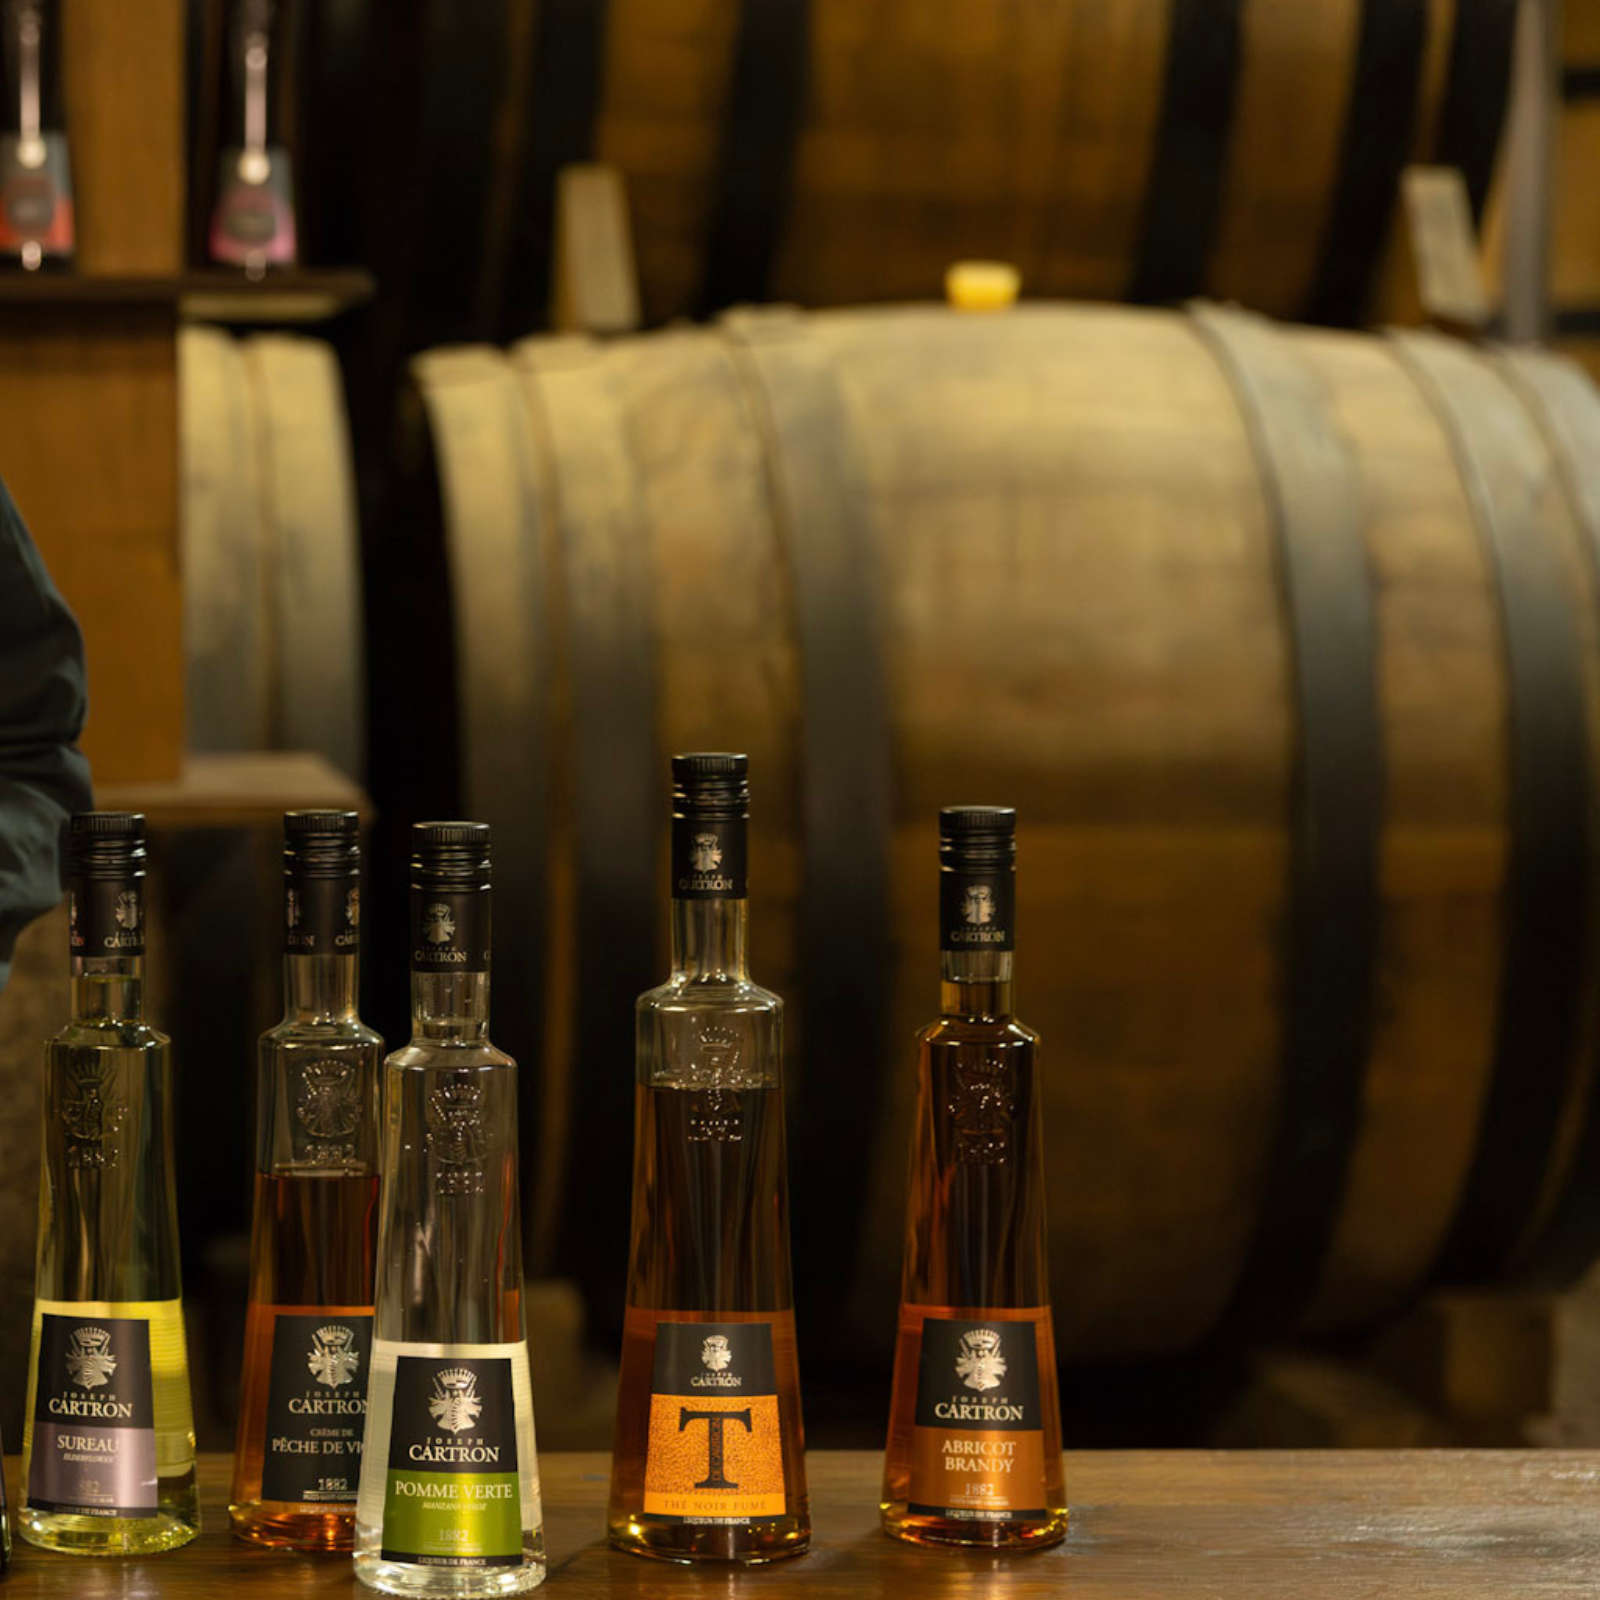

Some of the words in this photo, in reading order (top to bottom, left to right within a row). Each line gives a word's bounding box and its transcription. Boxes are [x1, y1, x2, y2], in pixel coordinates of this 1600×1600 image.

[690, 1376, 742, 1387] CARTRON
[63, 1391, 116, 1401] JOSEPH
[952, 1396, 1009, 1404] JOSEPH
[48, 1398, 133, 1419] CARTRON
[934, 1402, 1024, 1420] CARTRON
[341, 1428, 354, 1437] DE
[57, 1434, 119, 1453] SUREAU
[272, 1438, 320, 1454] PÊCHE
[323, 1441, 344, 1454] DE
[426, 1437, 485, 1445] JOSEPH
[679, 1406, 752, 1489] T
[942, 1439, 1016, 1455] ABRICOT
[409, 1444, 500, 1463] CARTRON
[945, 1457, 1014, 1473] BRANDY
[318, 1479, 348, 1491] 1882
[395, 1480, 458, 1498] POMME
[463, 1483, 513, 1499] VERTE
[965, 1484, 994, 1496] 1882
[693, 1501, 726, 1511] NOIR
[439, 1529, 469, 1542] 1882
